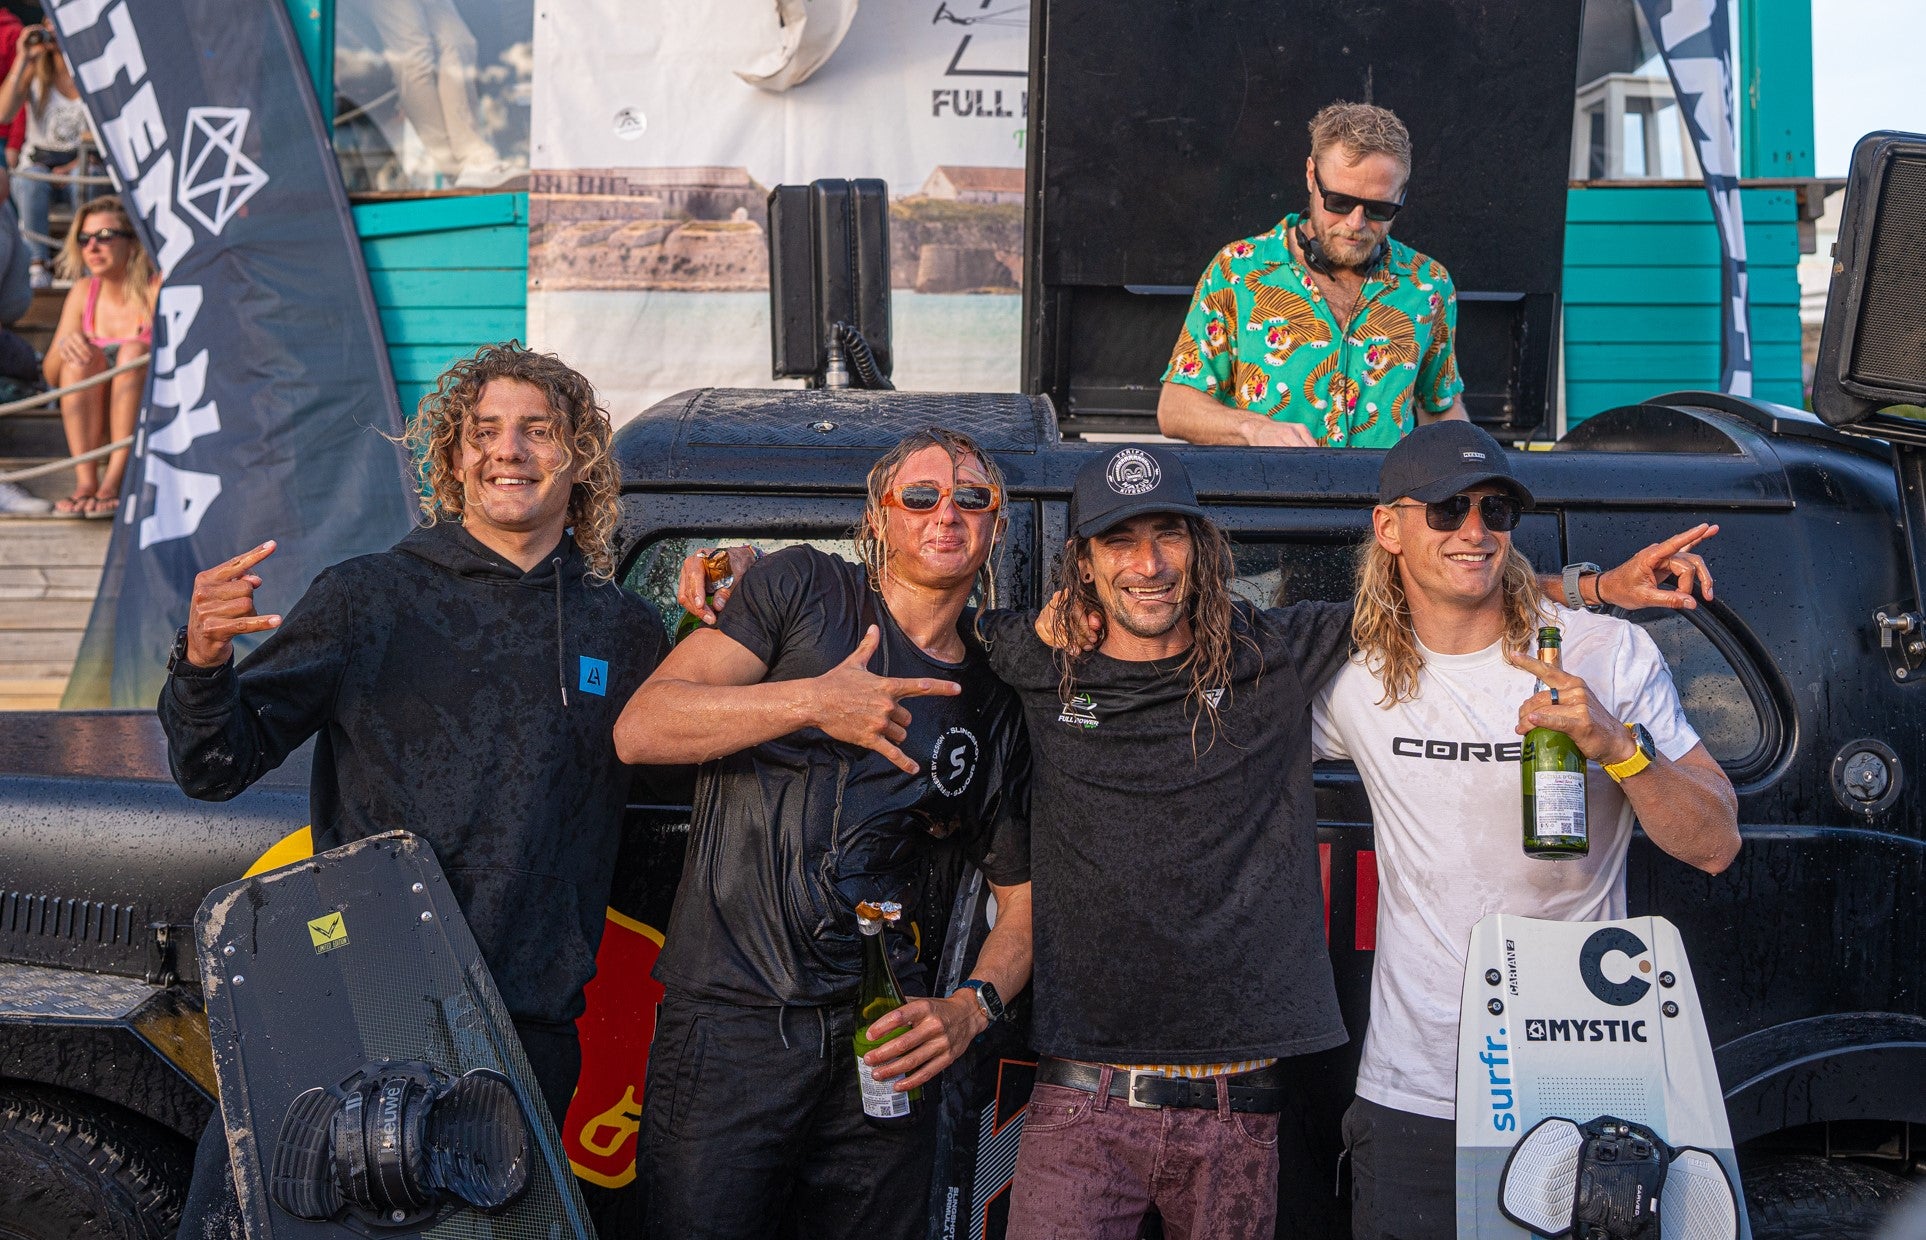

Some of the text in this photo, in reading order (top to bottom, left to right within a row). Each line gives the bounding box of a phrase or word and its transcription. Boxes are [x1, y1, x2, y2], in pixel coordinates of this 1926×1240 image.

[932, 89, 1013, 118] FULL
[54, 0, 222, 550] ITEMANA
[1058, 715, 1074, 723] FULL
[932, 734, 945, 759] DESIGN
[950, 726, 979, 797] SLINGSHOT SPORTS
[1393, 736, 1522, 763] CORE
[931, 760, 937, 771] BY
[1549, 1019, 1648, 1043] MYSTIC
[1479, 1027, 1516, 1132] surfr.
[944, 1186, 954, 1232] FORMULA
[950, 1186, 960, 1240] SLINGSHOT
[1634, 1184, 1643, 1217] CARVED
